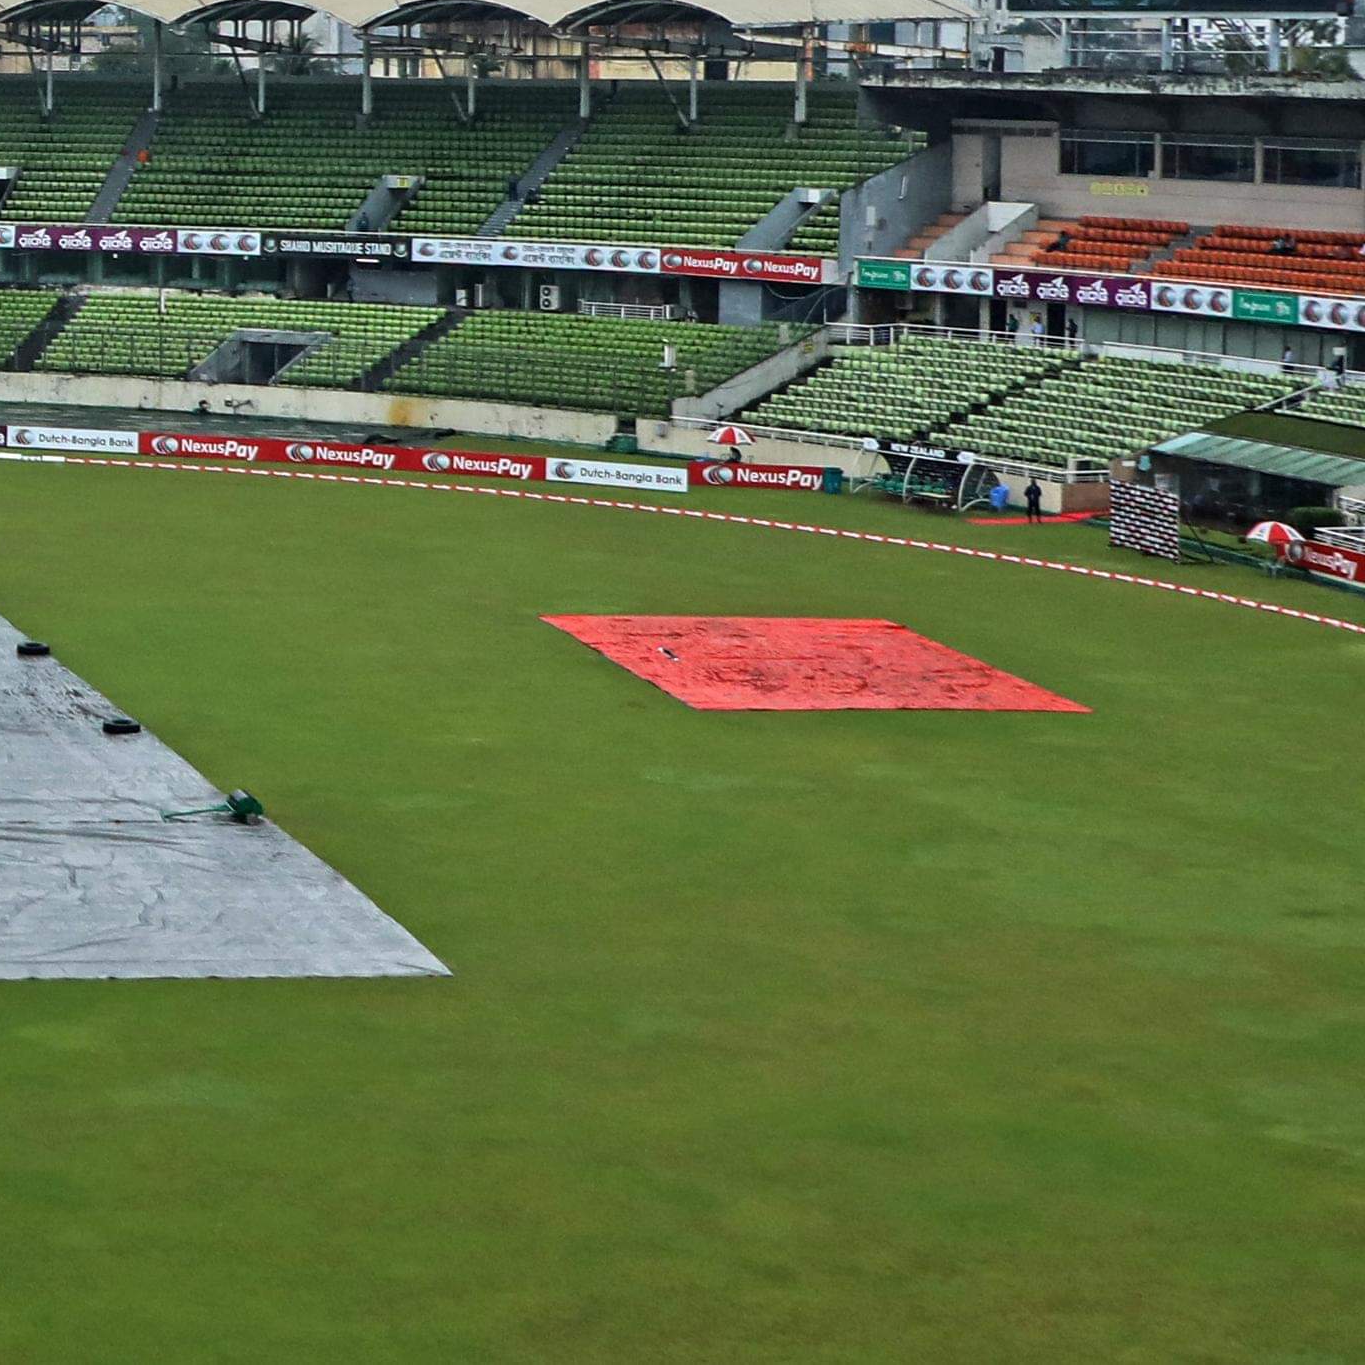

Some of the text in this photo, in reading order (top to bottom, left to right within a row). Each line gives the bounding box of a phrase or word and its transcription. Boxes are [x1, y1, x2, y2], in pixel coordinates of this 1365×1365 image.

[280, 240, 391, 255] SHAHID MUSHTAQUE STAND
[684, 255, 819, 280] NexusPay NexusPay
[39, 434, 134, 447] Dutch-Bangla Bank
[181, 438, 532, 480] NexusPay NexusPay NexusPay
[580, 466, 682, 485] Dutch-Bangla Bank
[737, 468, 823, 491] NexusPay
